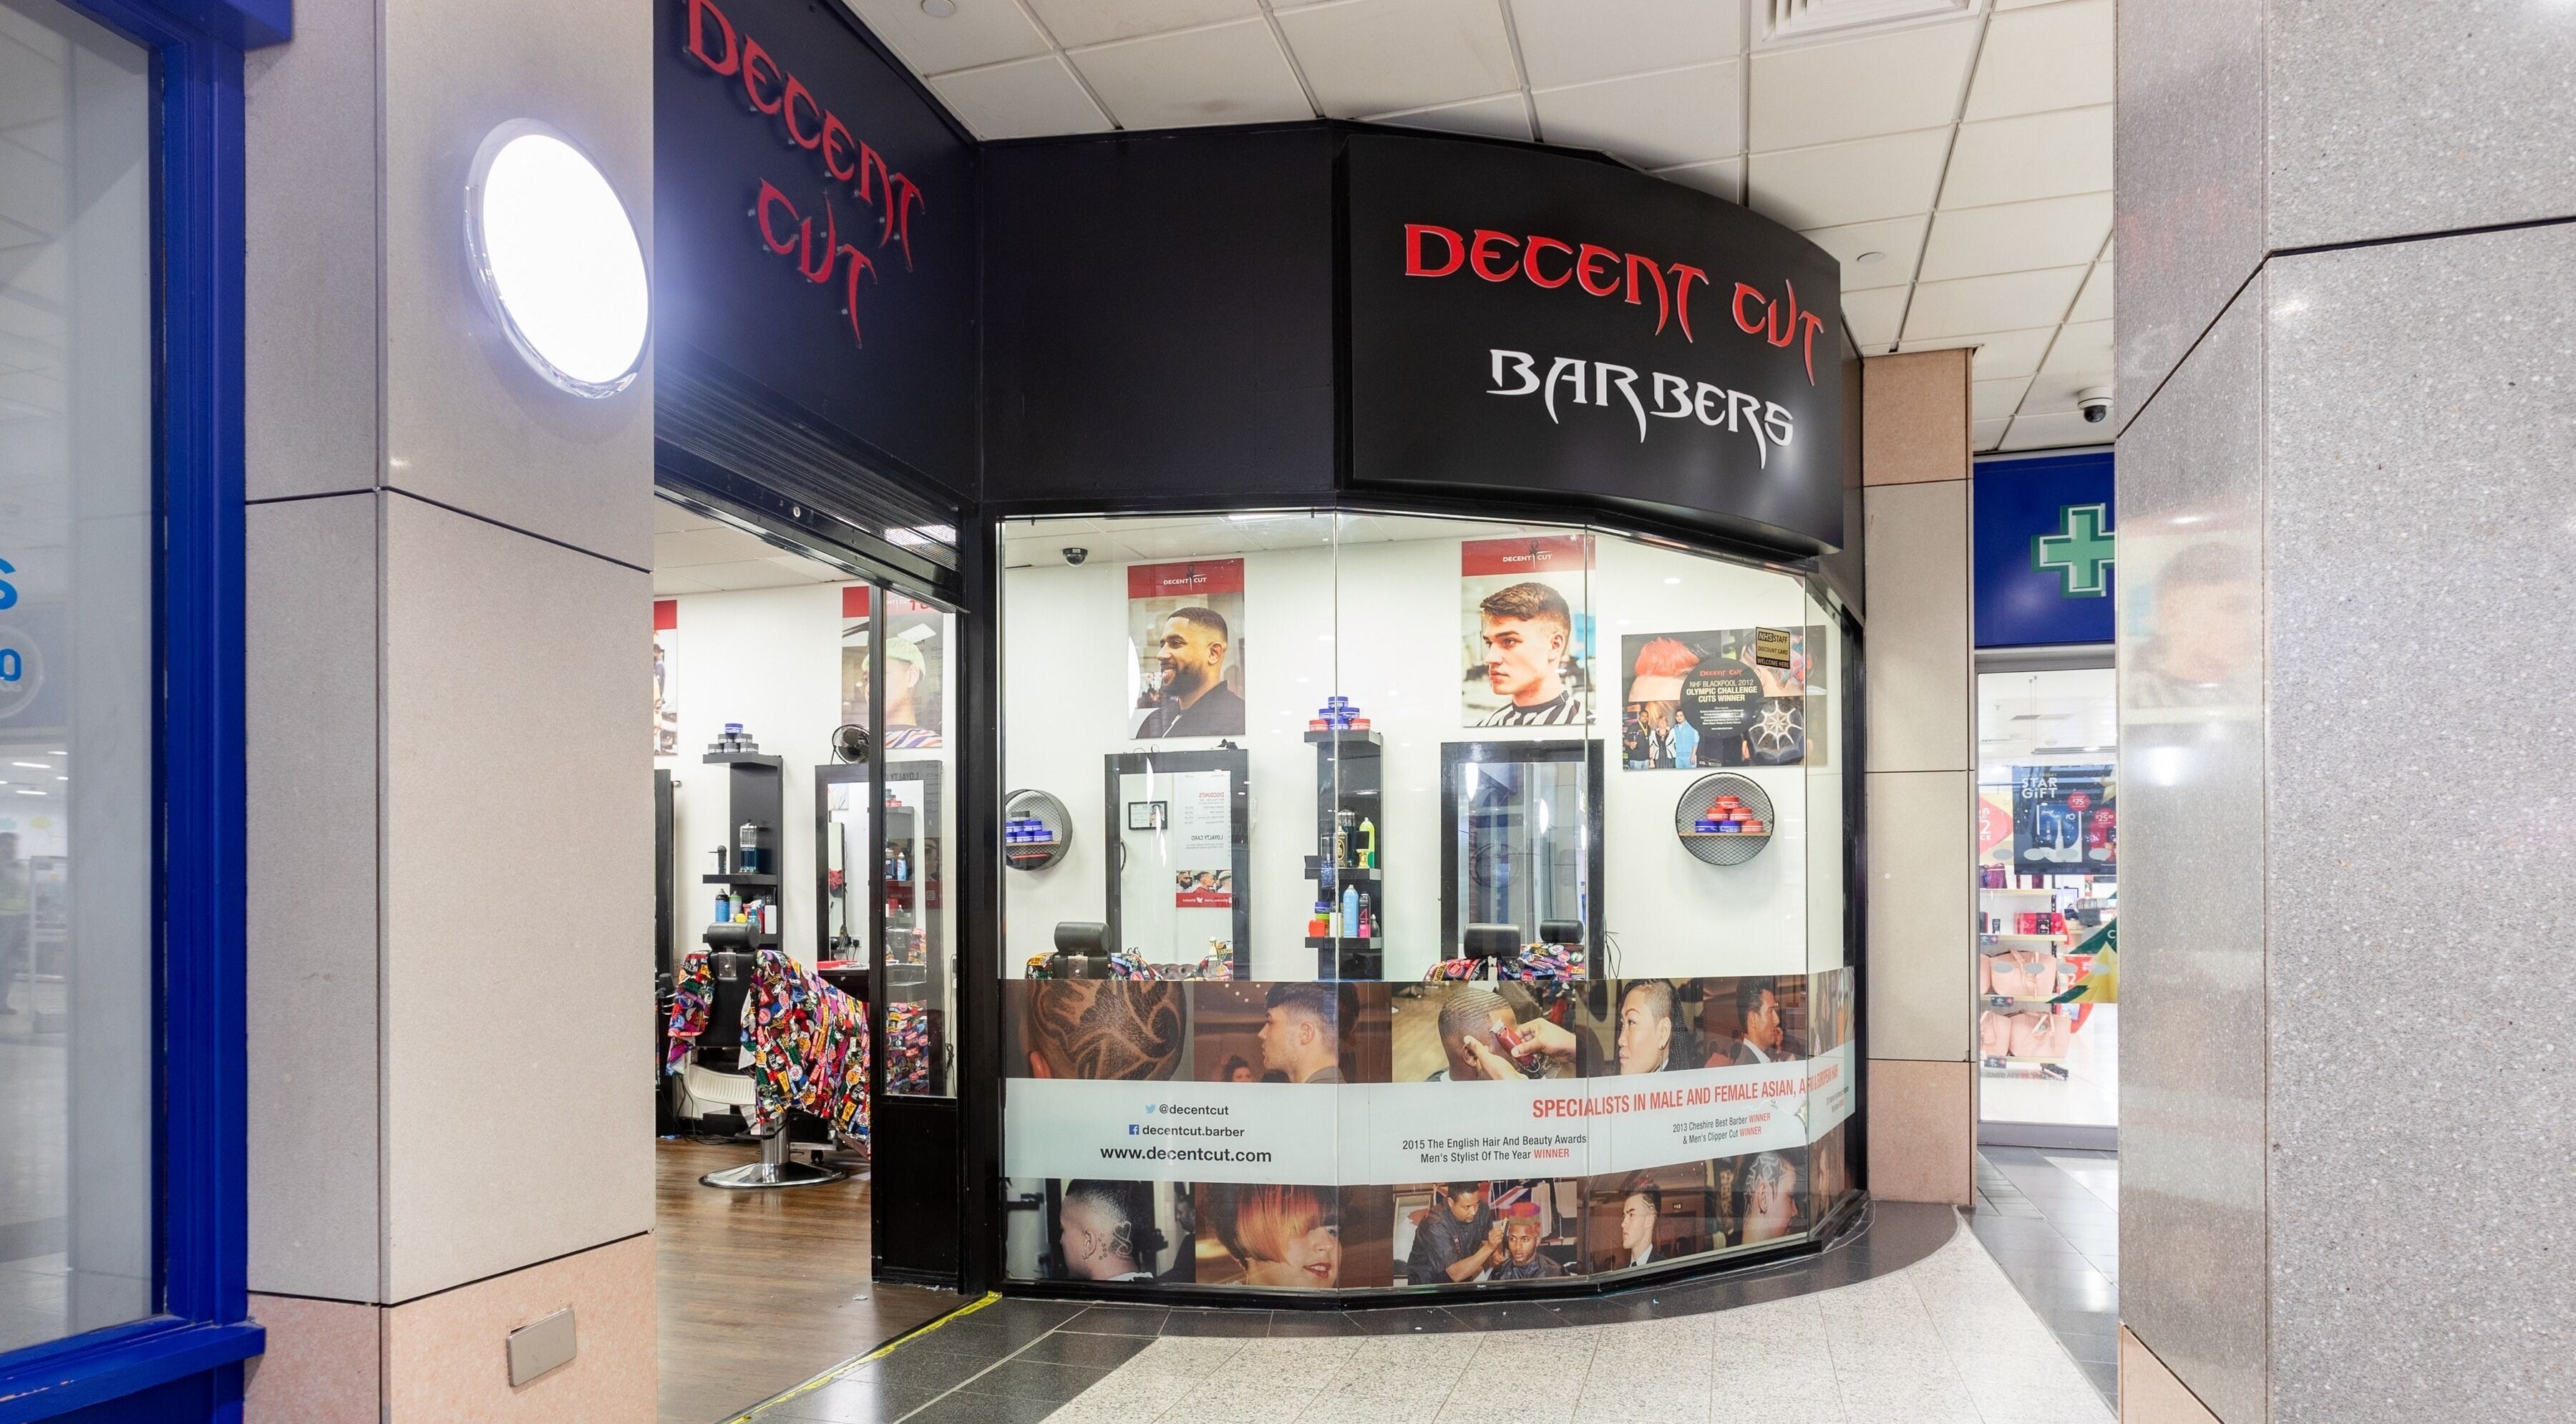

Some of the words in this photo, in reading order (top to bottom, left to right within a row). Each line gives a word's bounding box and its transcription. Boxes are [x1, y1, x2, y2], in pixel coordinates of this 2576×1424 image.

[689, 0, 925, 272] DECENT
[757, 177, 878, 348] CUT
[1404, 223, 1709, 343] DECENT
[1731, 278, 1824, 386] CUT
[1486, 348, 1794, 469] BARBERS
[1759, 632, 1773, 642] NHS
[2022, 777, 2058, 788] STAR
[1532, 1095, 1629, 1118] SPECIALISTS
[1634, 1093, 1646, 1111] IN
[1650, 1090, 1683, 1110] MALE
[1686, 1087, 1711, 1106] AND
[1715, 1083, 1758, 1103] FEMALE
[1761, 1079, 1797, 1098] ASIAN,
[1159, 1103, 1229, 1115] @decentcut
[1142, 1125, 1245, 1137] decentcut.barber
[1673, 1123, 1687, 1133] 2013
[1688, 1118, 1714, 1131] Cheshire
[1715, 1118, 1728, 1128] Best
[1729, 1116, 1747, 1126] Barber
[1749, 1113, 1771, 1123] WINNER
[1402, 1140, 1425, 1149] 2015
[1428, 1139, 1444, 1149] The
[1447, 1138, 1479, 1149] English
[1482, 1137, 1500, 1146] Hair
[1503, 1136, 1520, 1146] And
[1522, 1135, 1552, 1146] Beauty
[1555, 1134, 1586, 1143] Awards
[1683, 1136, 1688, 1144] &
[1689, 1133, 1706, 1143] Men's
[1708, 1131, 1728, 1143] Clipper
[1729, 1129, 1739, 1138] Cut
[1739, 1126, 1762, 1136] WINNER
[1100, 1146, 1272, 1162] www.decentcut.com
[1421, 1153, 1448, 1163] Men's
[1451, 1152, 1479, 1164] Stylist
[1482, 1151, 1491, 1161] Of
[1493, 1151, 1510, 1160] The
[1512, 1150, 1531, 1159] Year
[1534, 1149, 1570, 1159] WINNER
